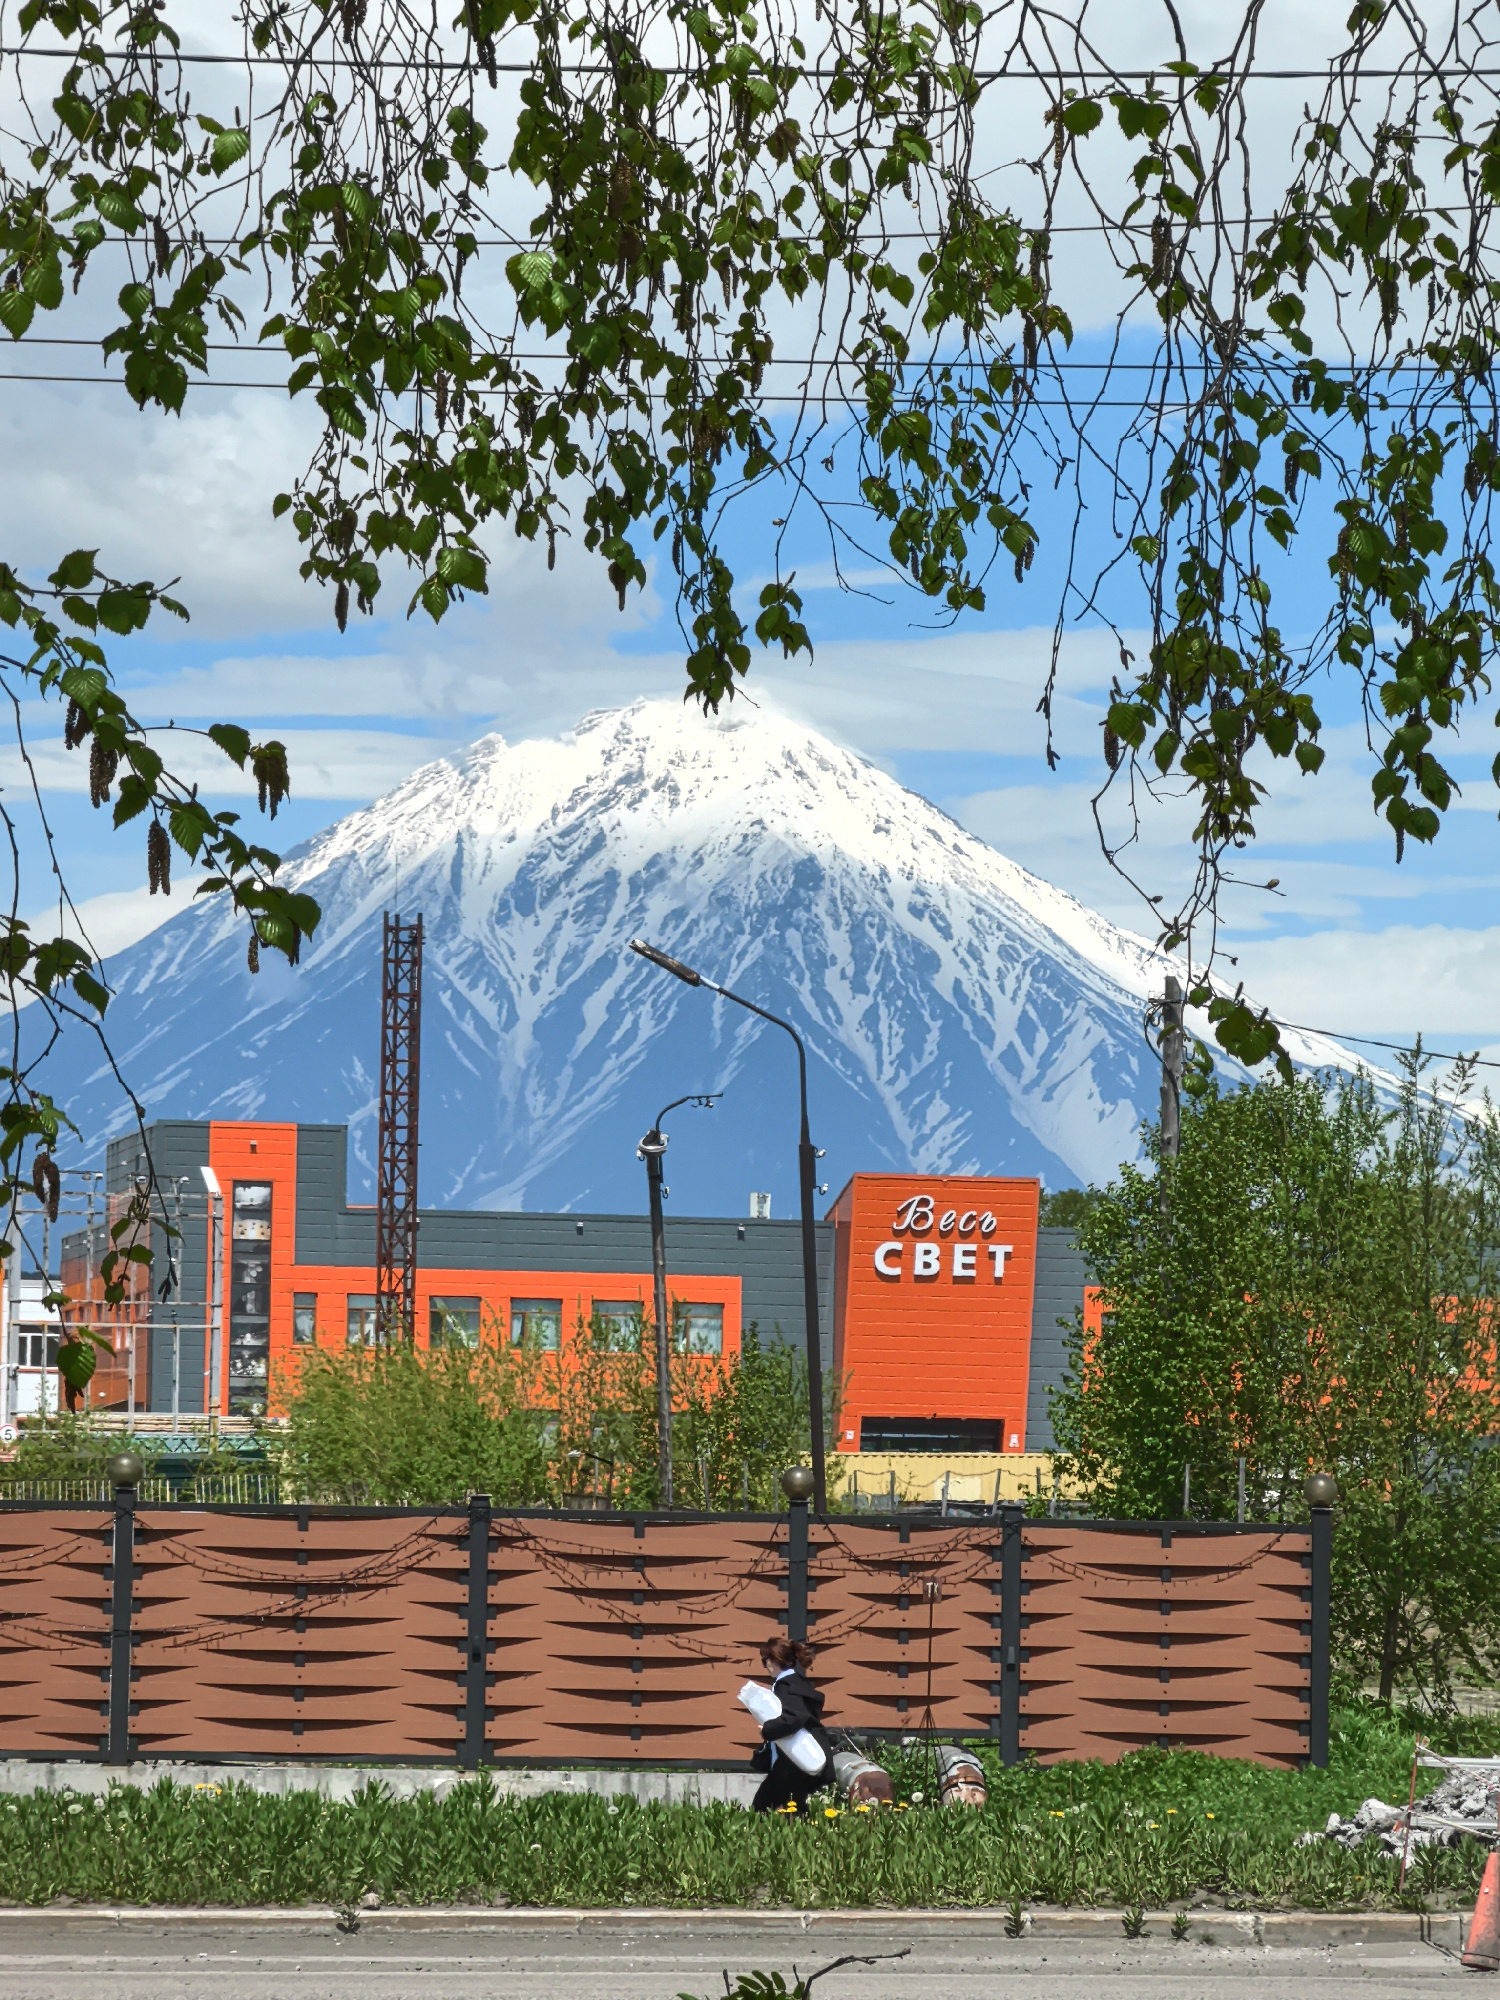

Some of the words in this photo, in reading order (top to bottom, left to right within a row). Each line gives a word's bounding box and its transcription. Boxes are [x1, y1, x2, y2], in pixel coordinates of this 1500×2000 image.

[893, 1195, 997, 1233] Весь
[874, 1241, 1014, 1278] СВЕТ
[4, 1428, 13, 1441] 5
